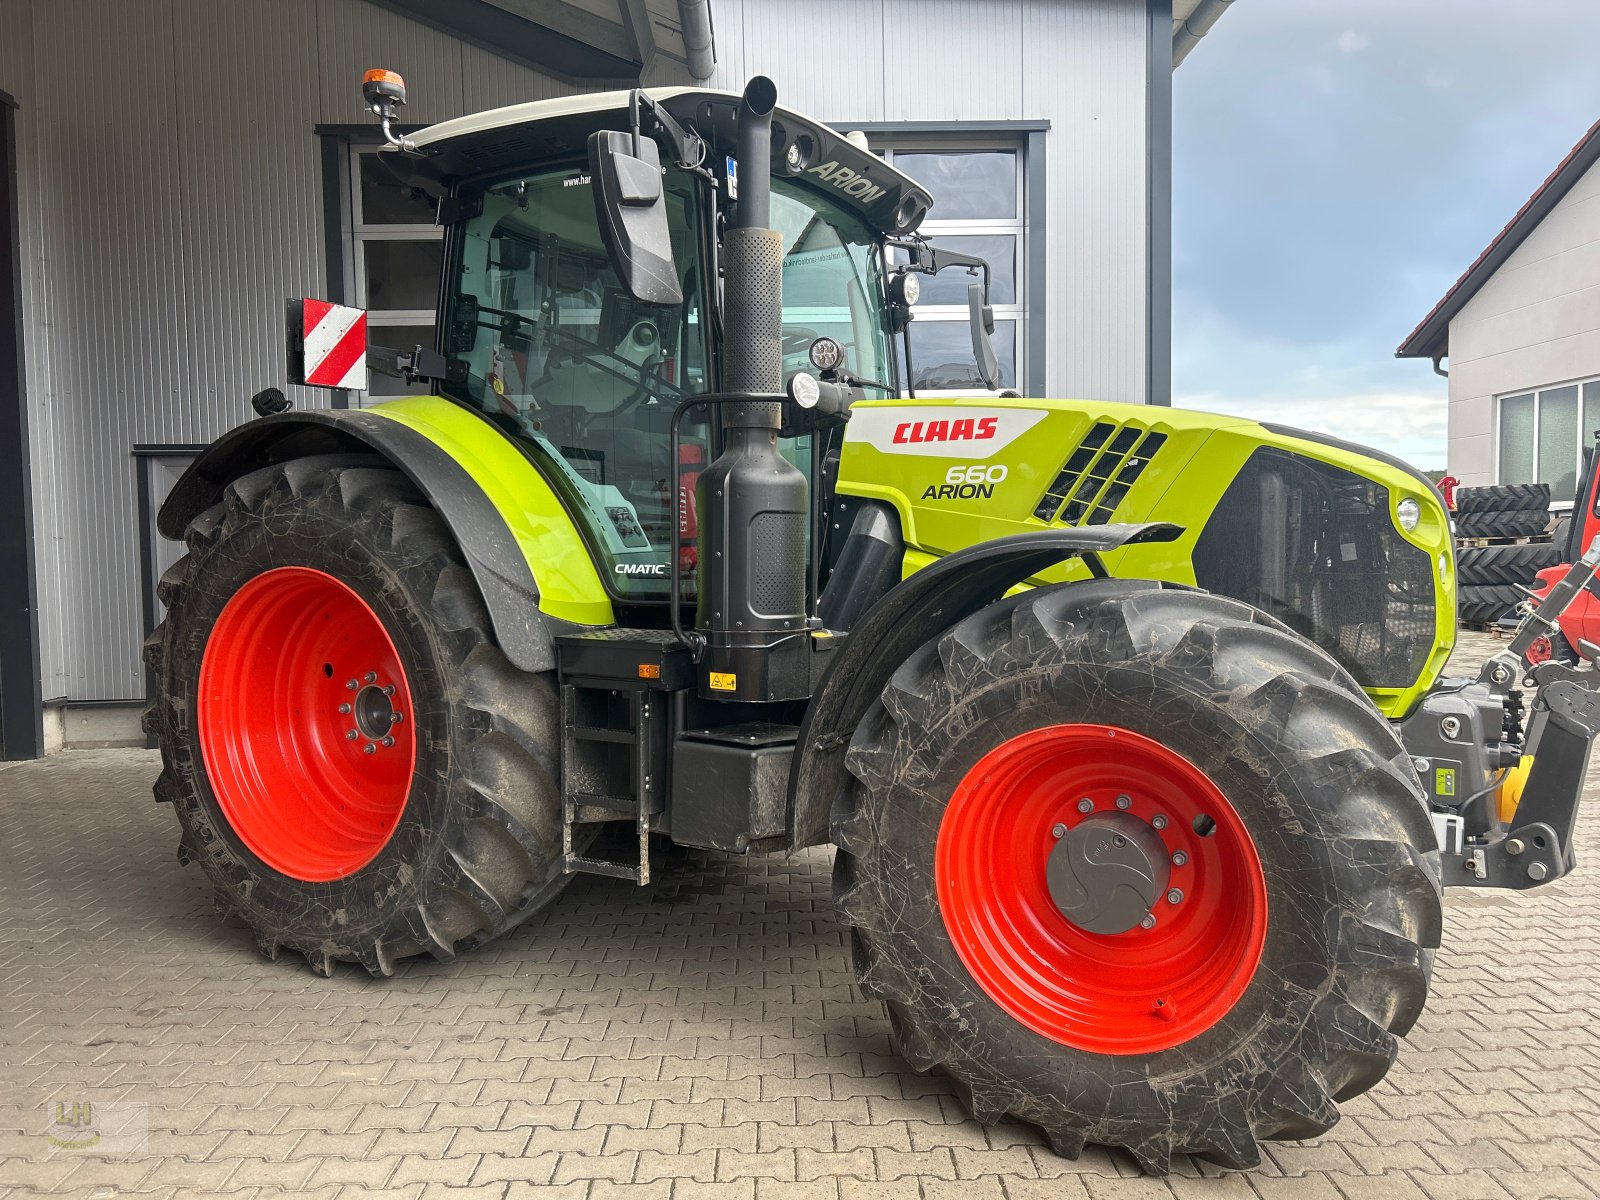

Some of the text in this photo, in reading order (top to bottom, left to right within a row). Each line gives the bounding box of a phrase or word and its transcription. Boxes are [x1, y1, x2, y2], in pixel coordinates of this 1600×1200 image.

[806, 160, 887, 203] ARION
[892, 417, 999, 444] CLAAS
[945, 464, 1008, 484] 660
[921, 484, 995, 500] ARION
[614, 563, 666, 575] CMATIC
